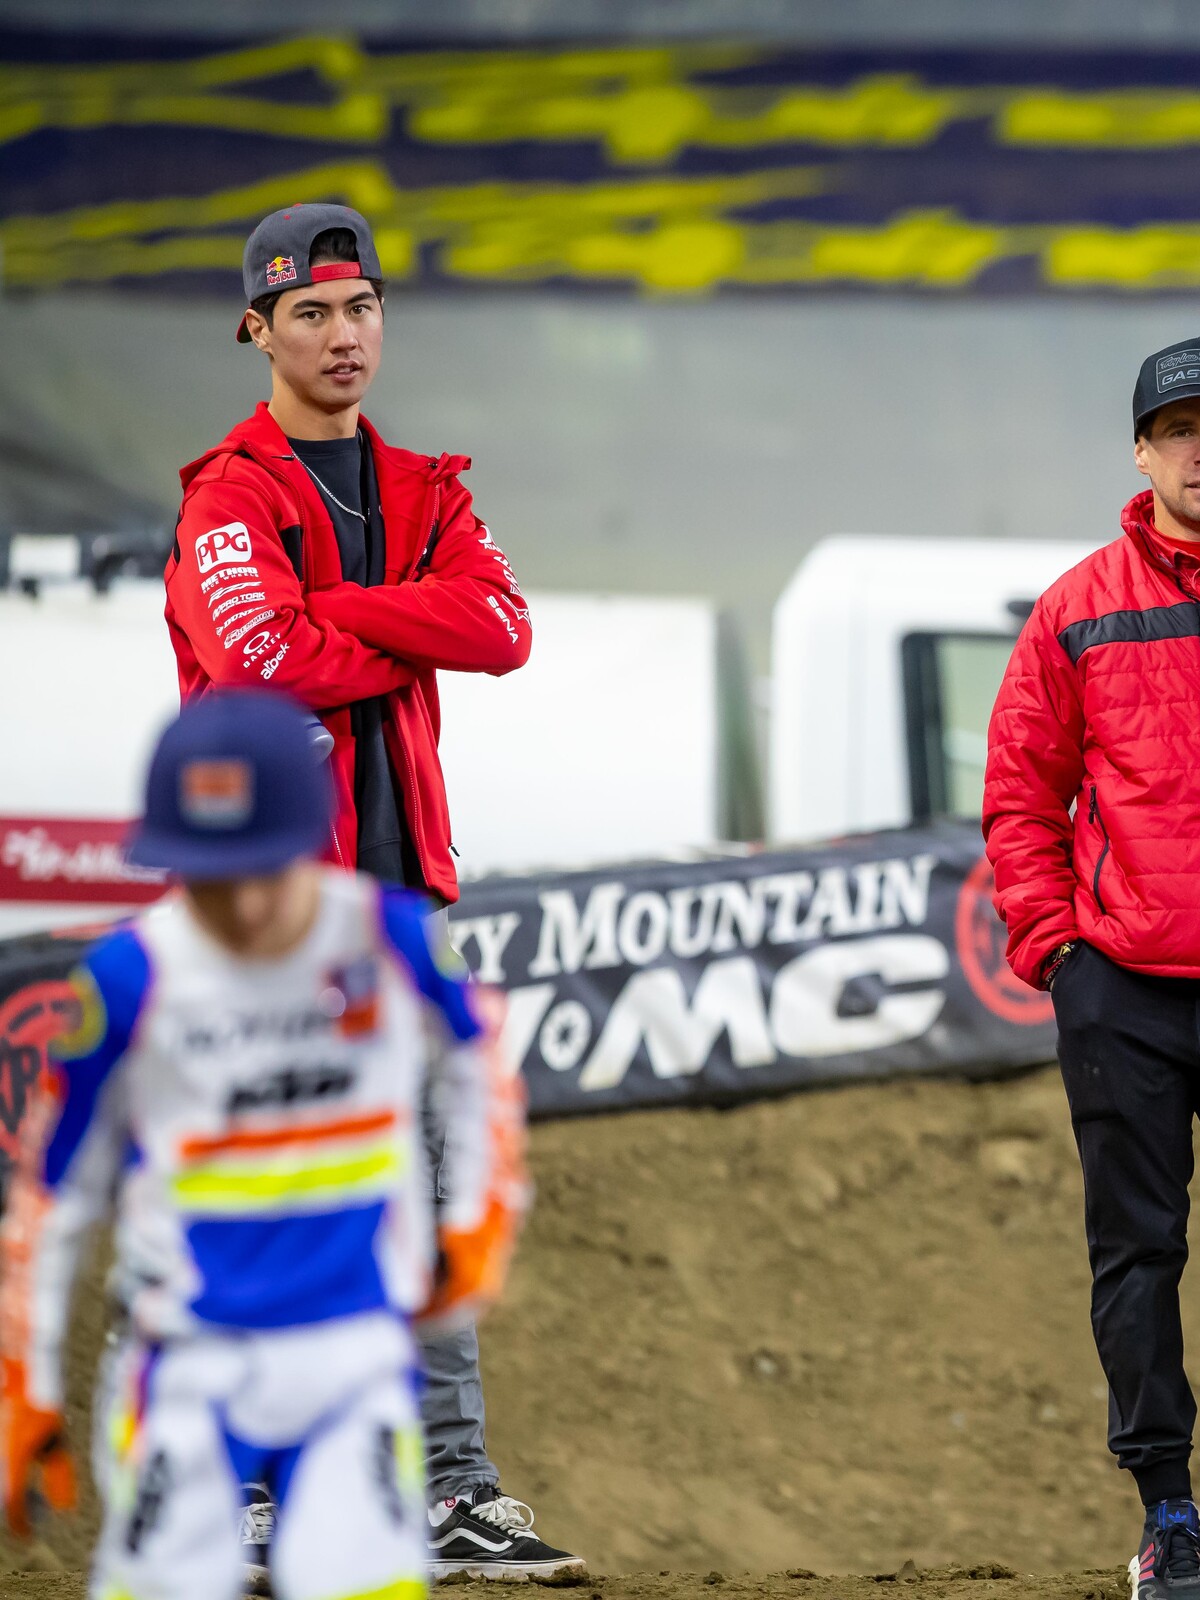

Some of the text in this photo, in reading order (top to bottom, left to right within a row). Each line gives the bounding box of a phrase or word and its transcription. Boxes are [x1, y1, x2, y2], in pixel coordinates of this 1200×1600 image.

[267, 268, 297, 285] Red Bull
[197, 531, 249, 567] PPG
[201, 566, 259, 591] METHOD
[240, 592, 266, 601] TORK
[486, 595, 519, 644] SENA
[242, 633, 281, 668] OAKLEY
[261, 642, 291, 680] albek
[528, 855, 938, 979] MOUNTAIN
